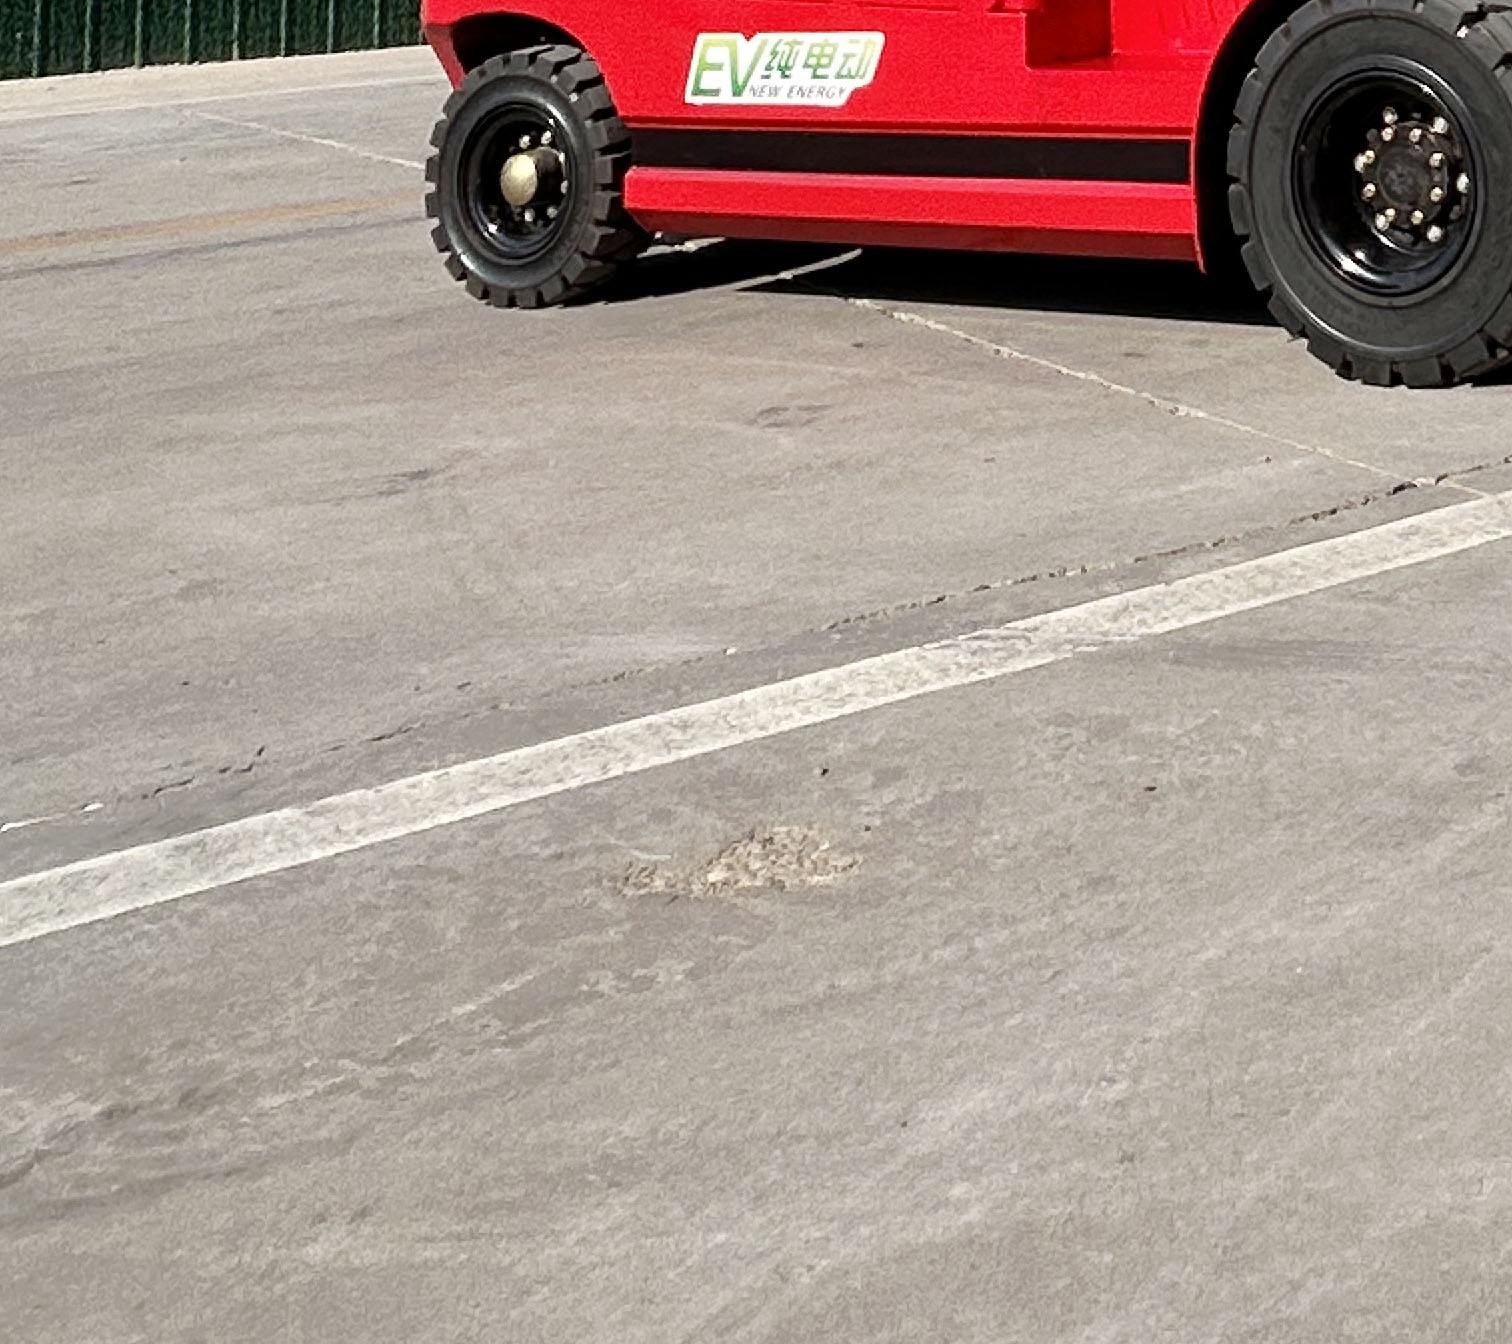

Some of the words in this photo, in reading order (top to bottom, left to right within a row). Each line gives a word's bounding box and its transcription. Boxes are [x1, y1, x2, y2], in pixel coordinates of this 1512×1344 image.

[691, 38, 768, 97] EV
[761, 38, 877, 79] 纯电动
[749, 84, 784, 98] NEW
[787, 84, 847, 99] ENERGY
